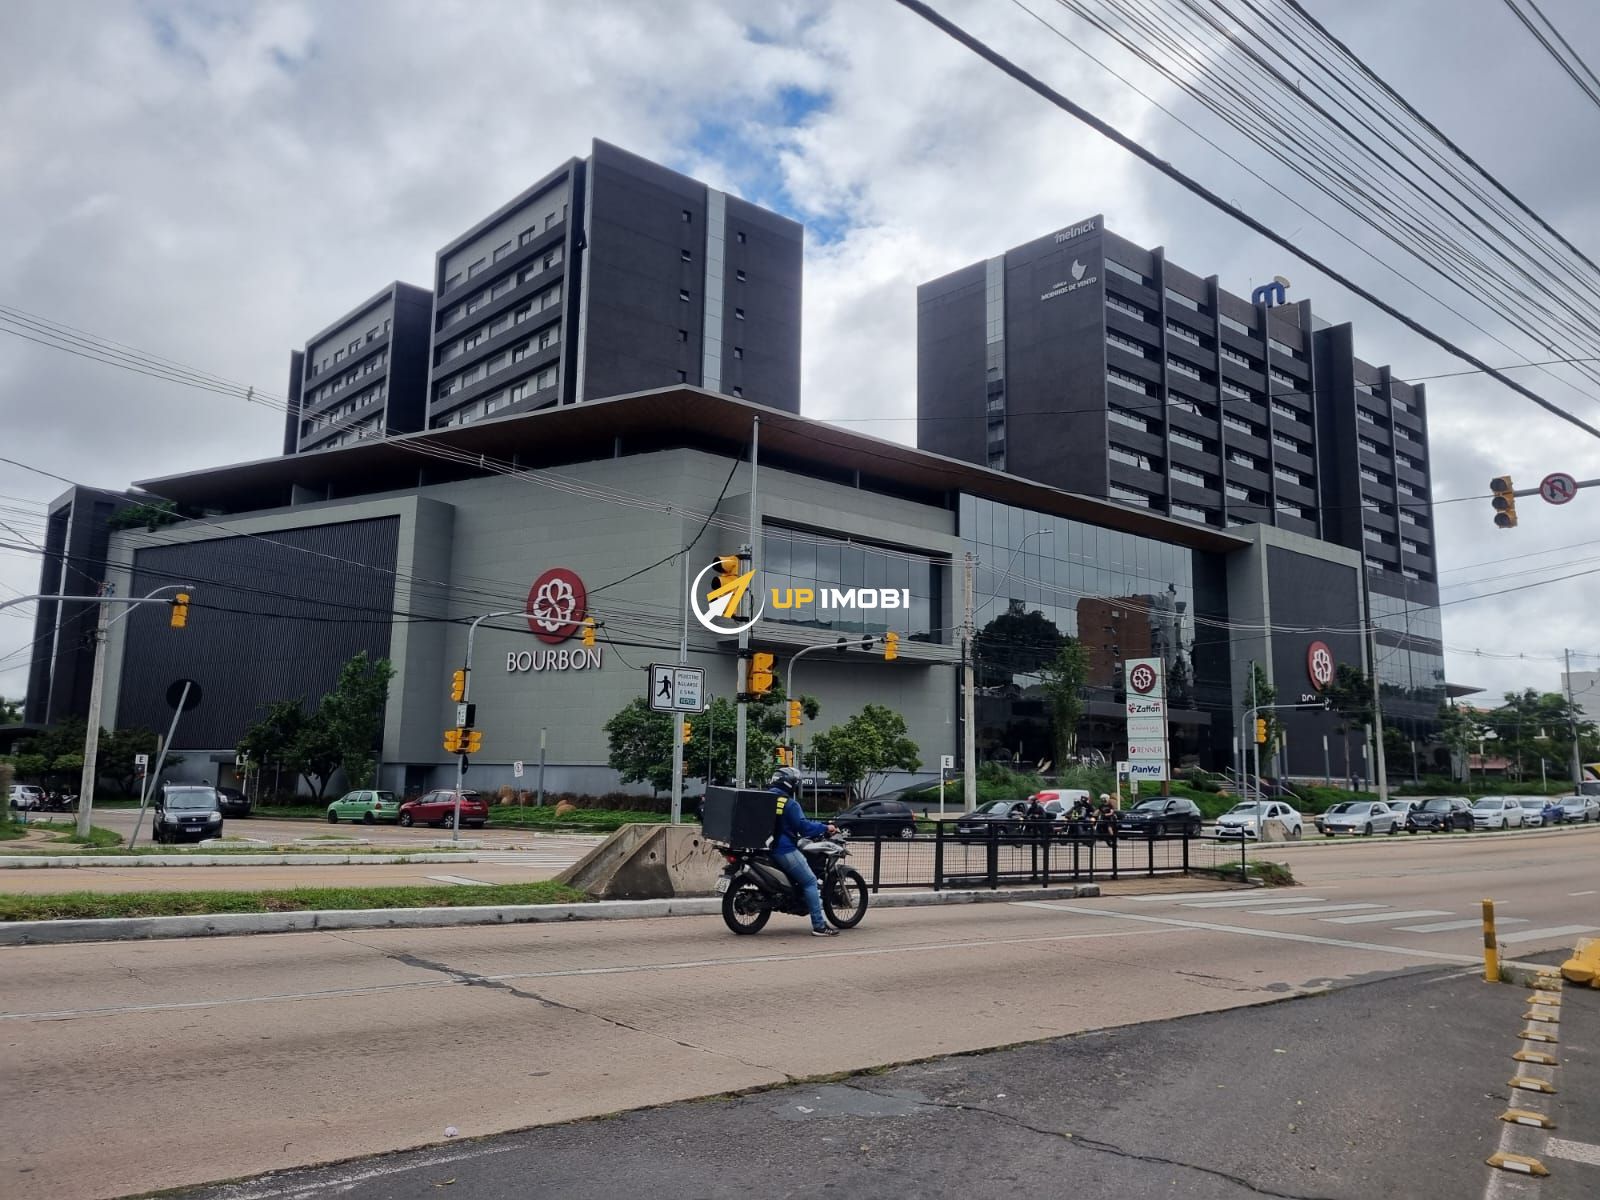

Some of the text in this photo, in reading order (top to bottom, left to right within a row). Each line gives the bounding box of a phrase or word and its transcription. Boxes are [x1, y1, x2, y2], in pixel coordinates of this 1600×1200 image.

[1054, 220, 1095, 243] melnick
[506, 648, 602, 672] BOURBON
[1131, 765, 1161, 773] PanVel
